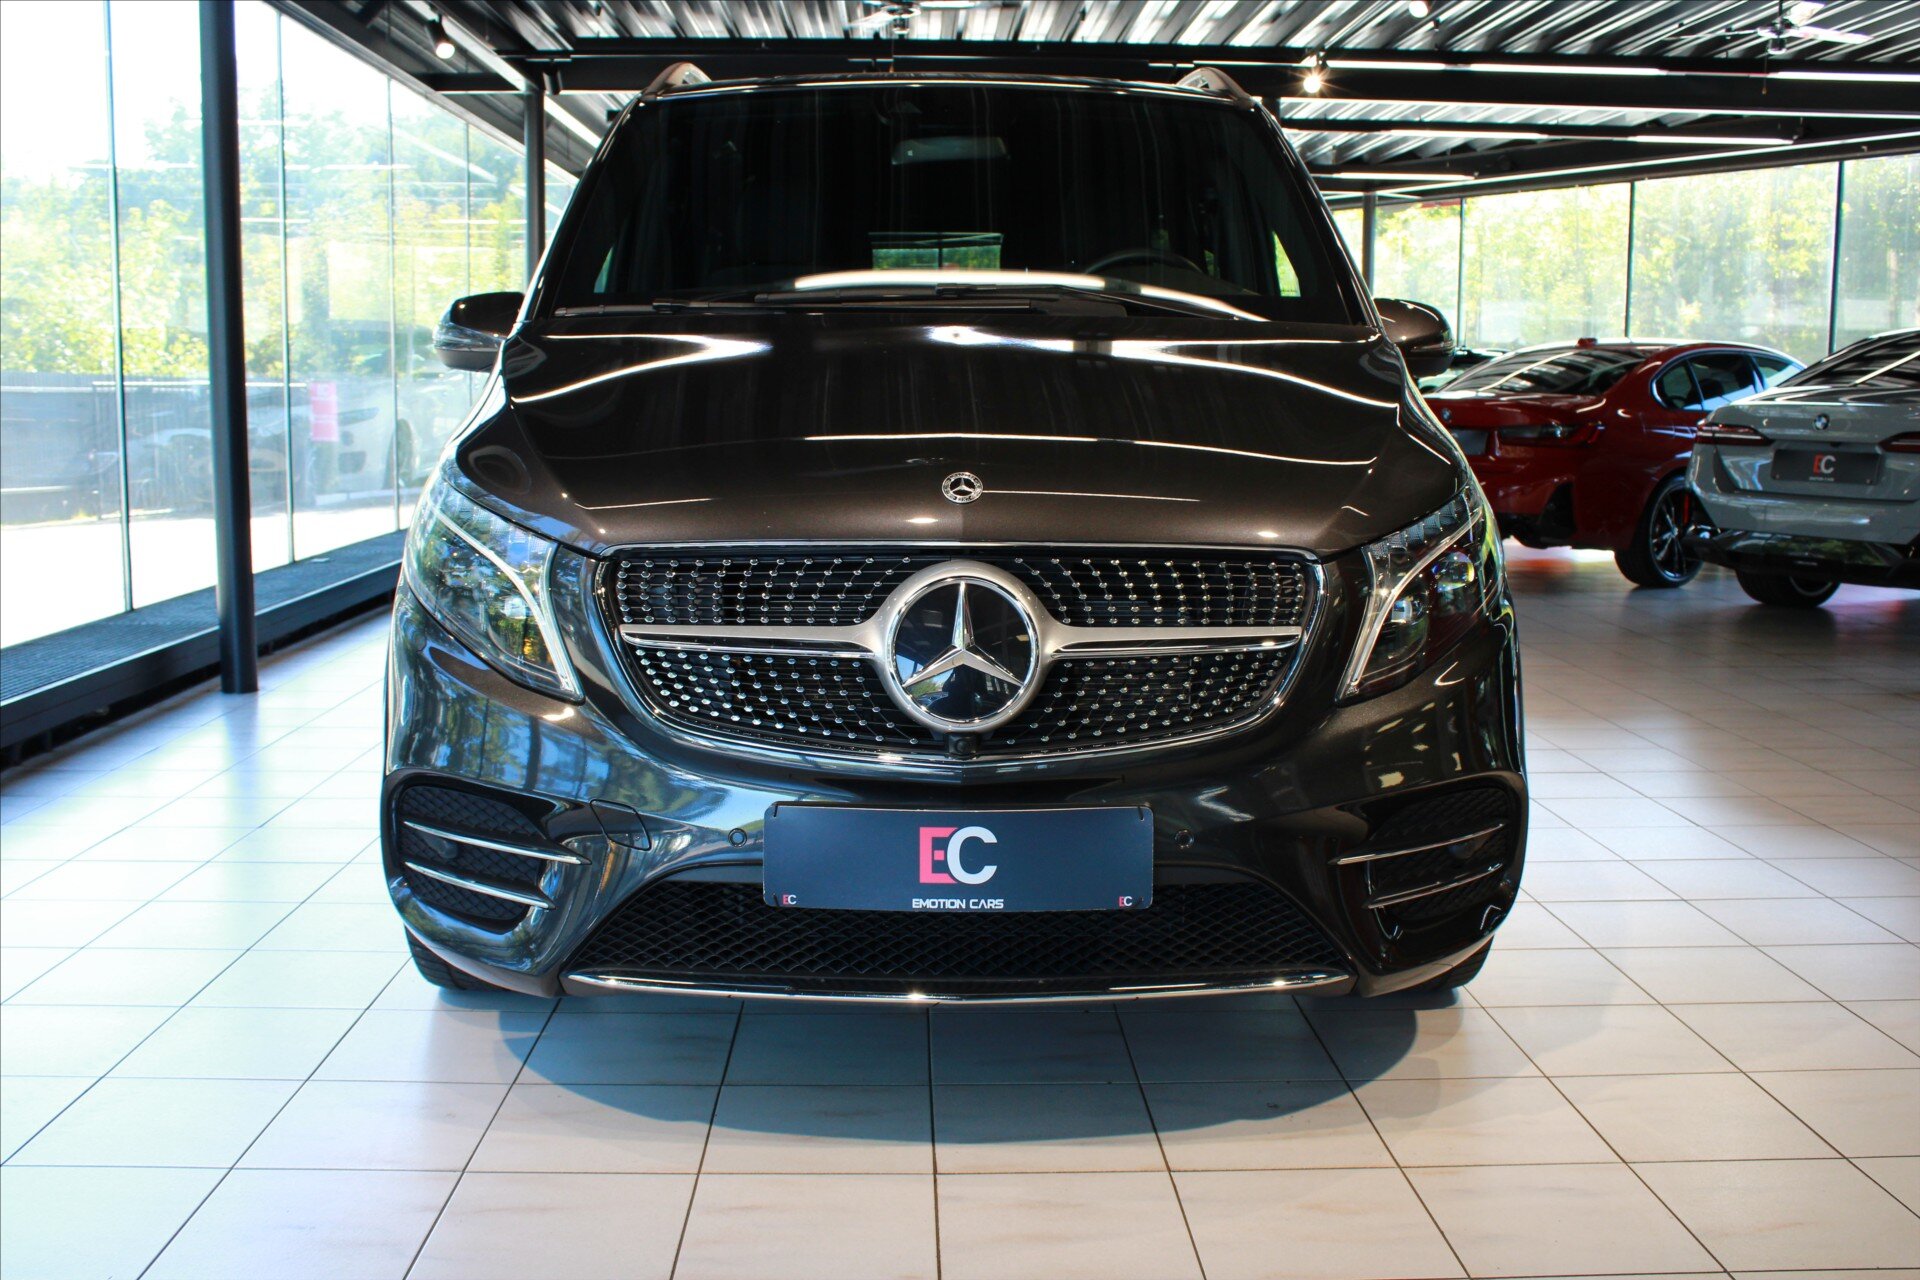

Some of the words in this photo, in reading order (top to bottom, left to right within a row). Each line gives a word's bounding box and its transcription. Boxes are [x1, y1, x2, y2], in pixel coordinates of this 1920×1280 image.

[919, 826, 998, 885] EC
[782, 894, 797, 905] EC
[912, 898, 966, 909] EMOTION
[969, 898, 1004, 909] CARS
[1119, 896, 1133, 907] EC
